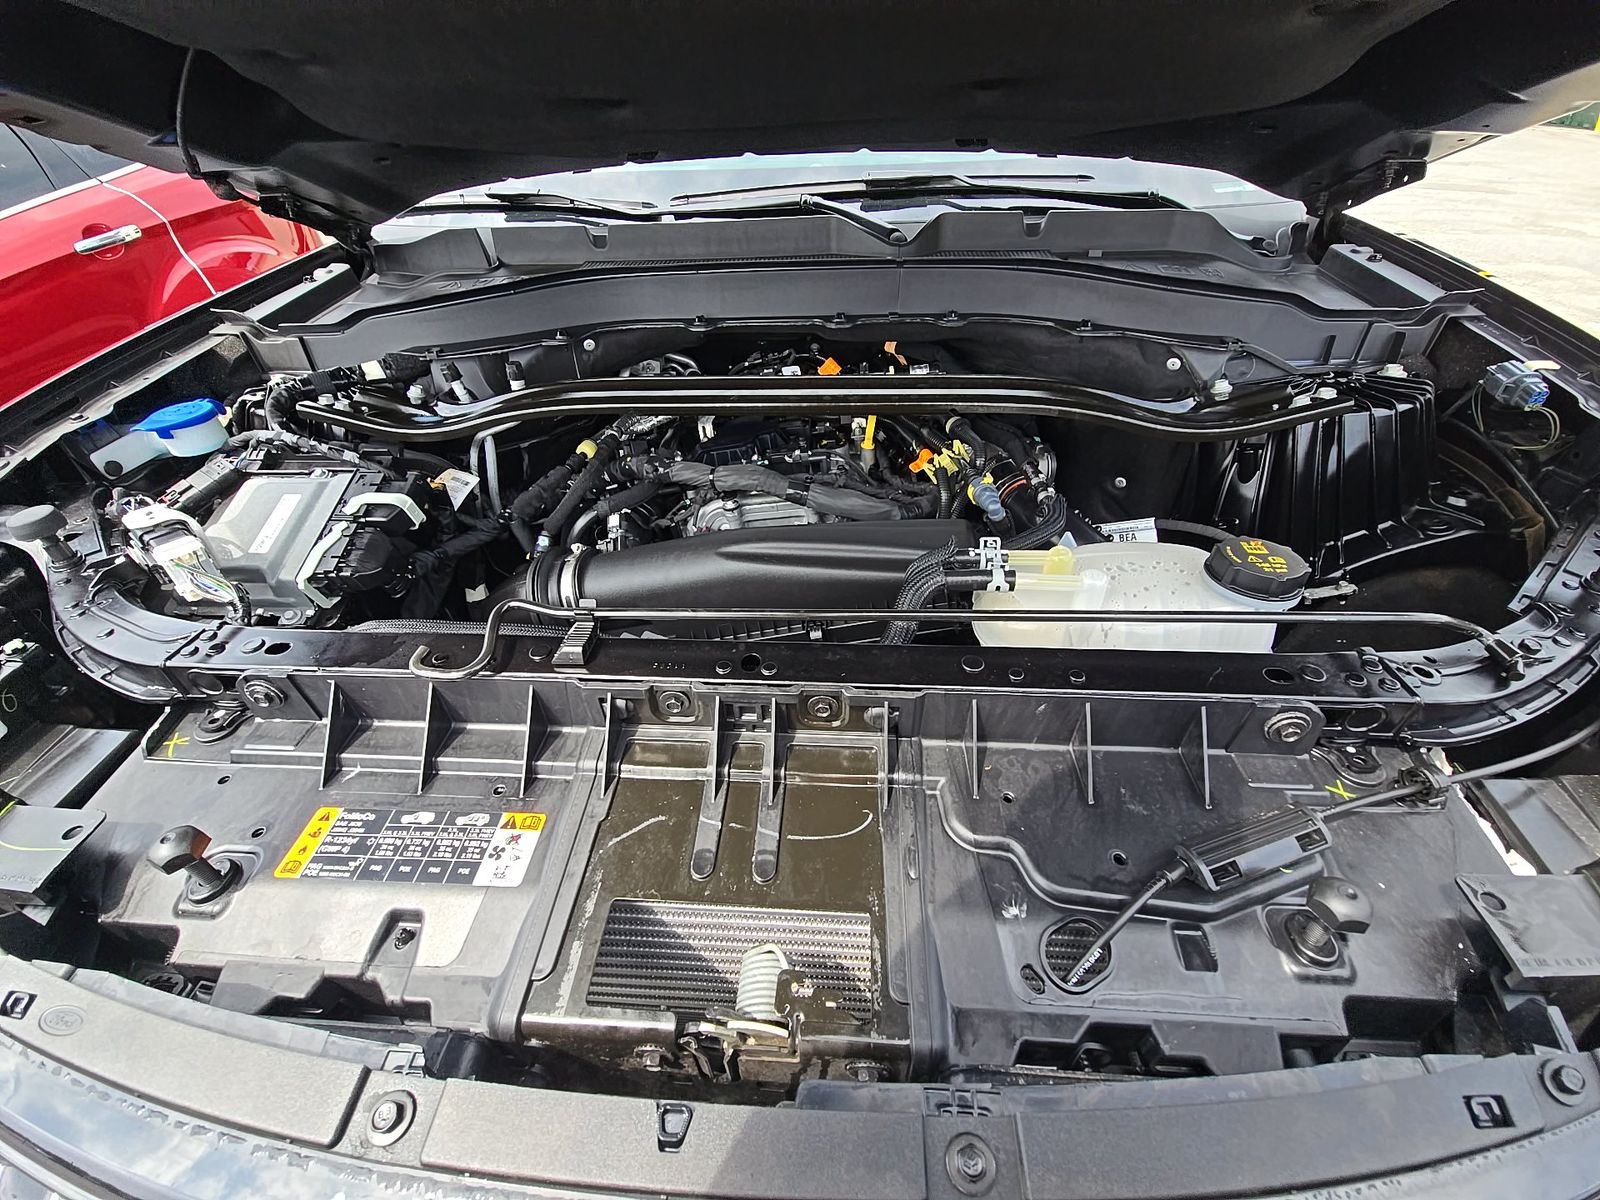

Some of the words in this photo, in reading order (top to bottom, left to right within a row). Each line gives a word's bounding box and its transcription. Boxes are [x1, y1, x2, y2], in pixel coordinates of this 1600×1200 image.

[1119, 533, 1137, 542] BEA
[340, 811, 376, 820] FoMoCo
[323, 835, 360, 846] R-1234yf
